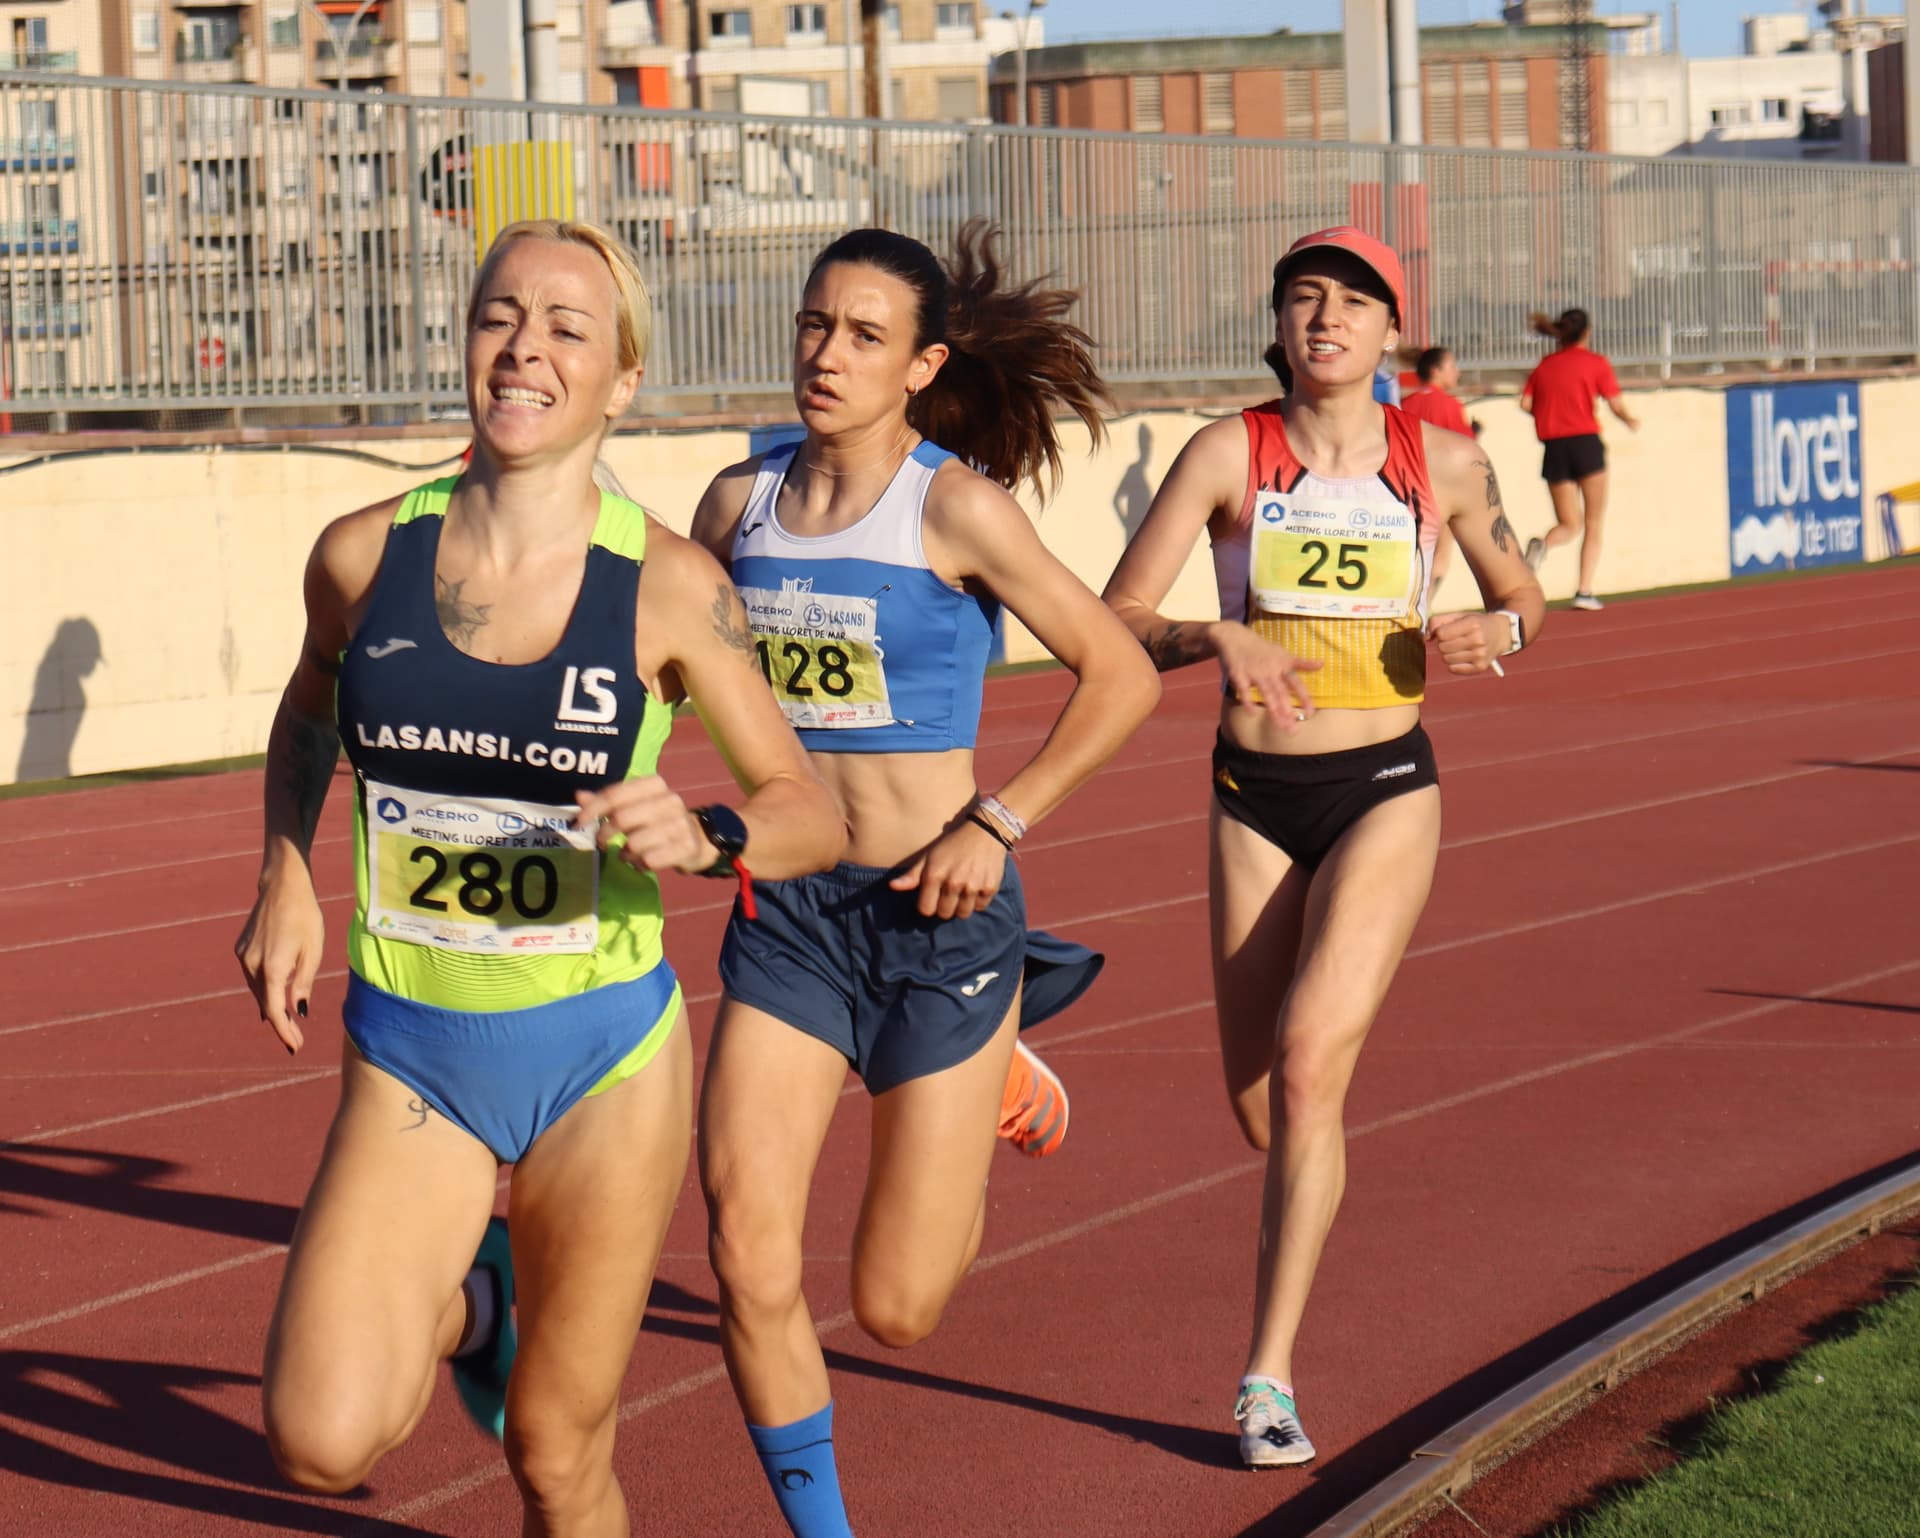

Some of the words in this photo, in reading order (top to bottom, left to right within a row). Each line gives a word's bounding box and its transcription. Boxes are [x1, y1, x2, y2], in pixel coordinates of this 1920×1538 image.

[1752, 391, 1860, 507] lloret
[1291, 509, 1336, 520] ACERKO
[1285, 525, 1321, 536] MEETING
[1324, 528, 1355, 537] LLORET
[1373, 532, 1392, 540] MAR
[1803, 511, 1825, 556] de
[1828, 517, 1860, 553] mar
[1297, 540, 1369, 591] 25
[750, 605, 793, 616] ACERKO
[807, 608, 822, 623] LS
[829, 610, 866, 627] LASANSI
[782, 626, 812, 638] LLORET
[815, 630, 825, 639] DE
[828, 631, 847, 640] MAR
[756, 640, 854, 697] 128
[557, 665, 618, 724] LS
[356, 723, 609, 776] LASANSI.COM
[415, 808, 479, 823] ACERKO
[534, 816, 585, 833] LASA
[410, 827, 460, 844] MEETING
[463, 834, 507, 848] LLORET
[512, 838, 528, 848] DE
[531, 838, 561, 849] MAR
[409, 845, 560, 920] 280
